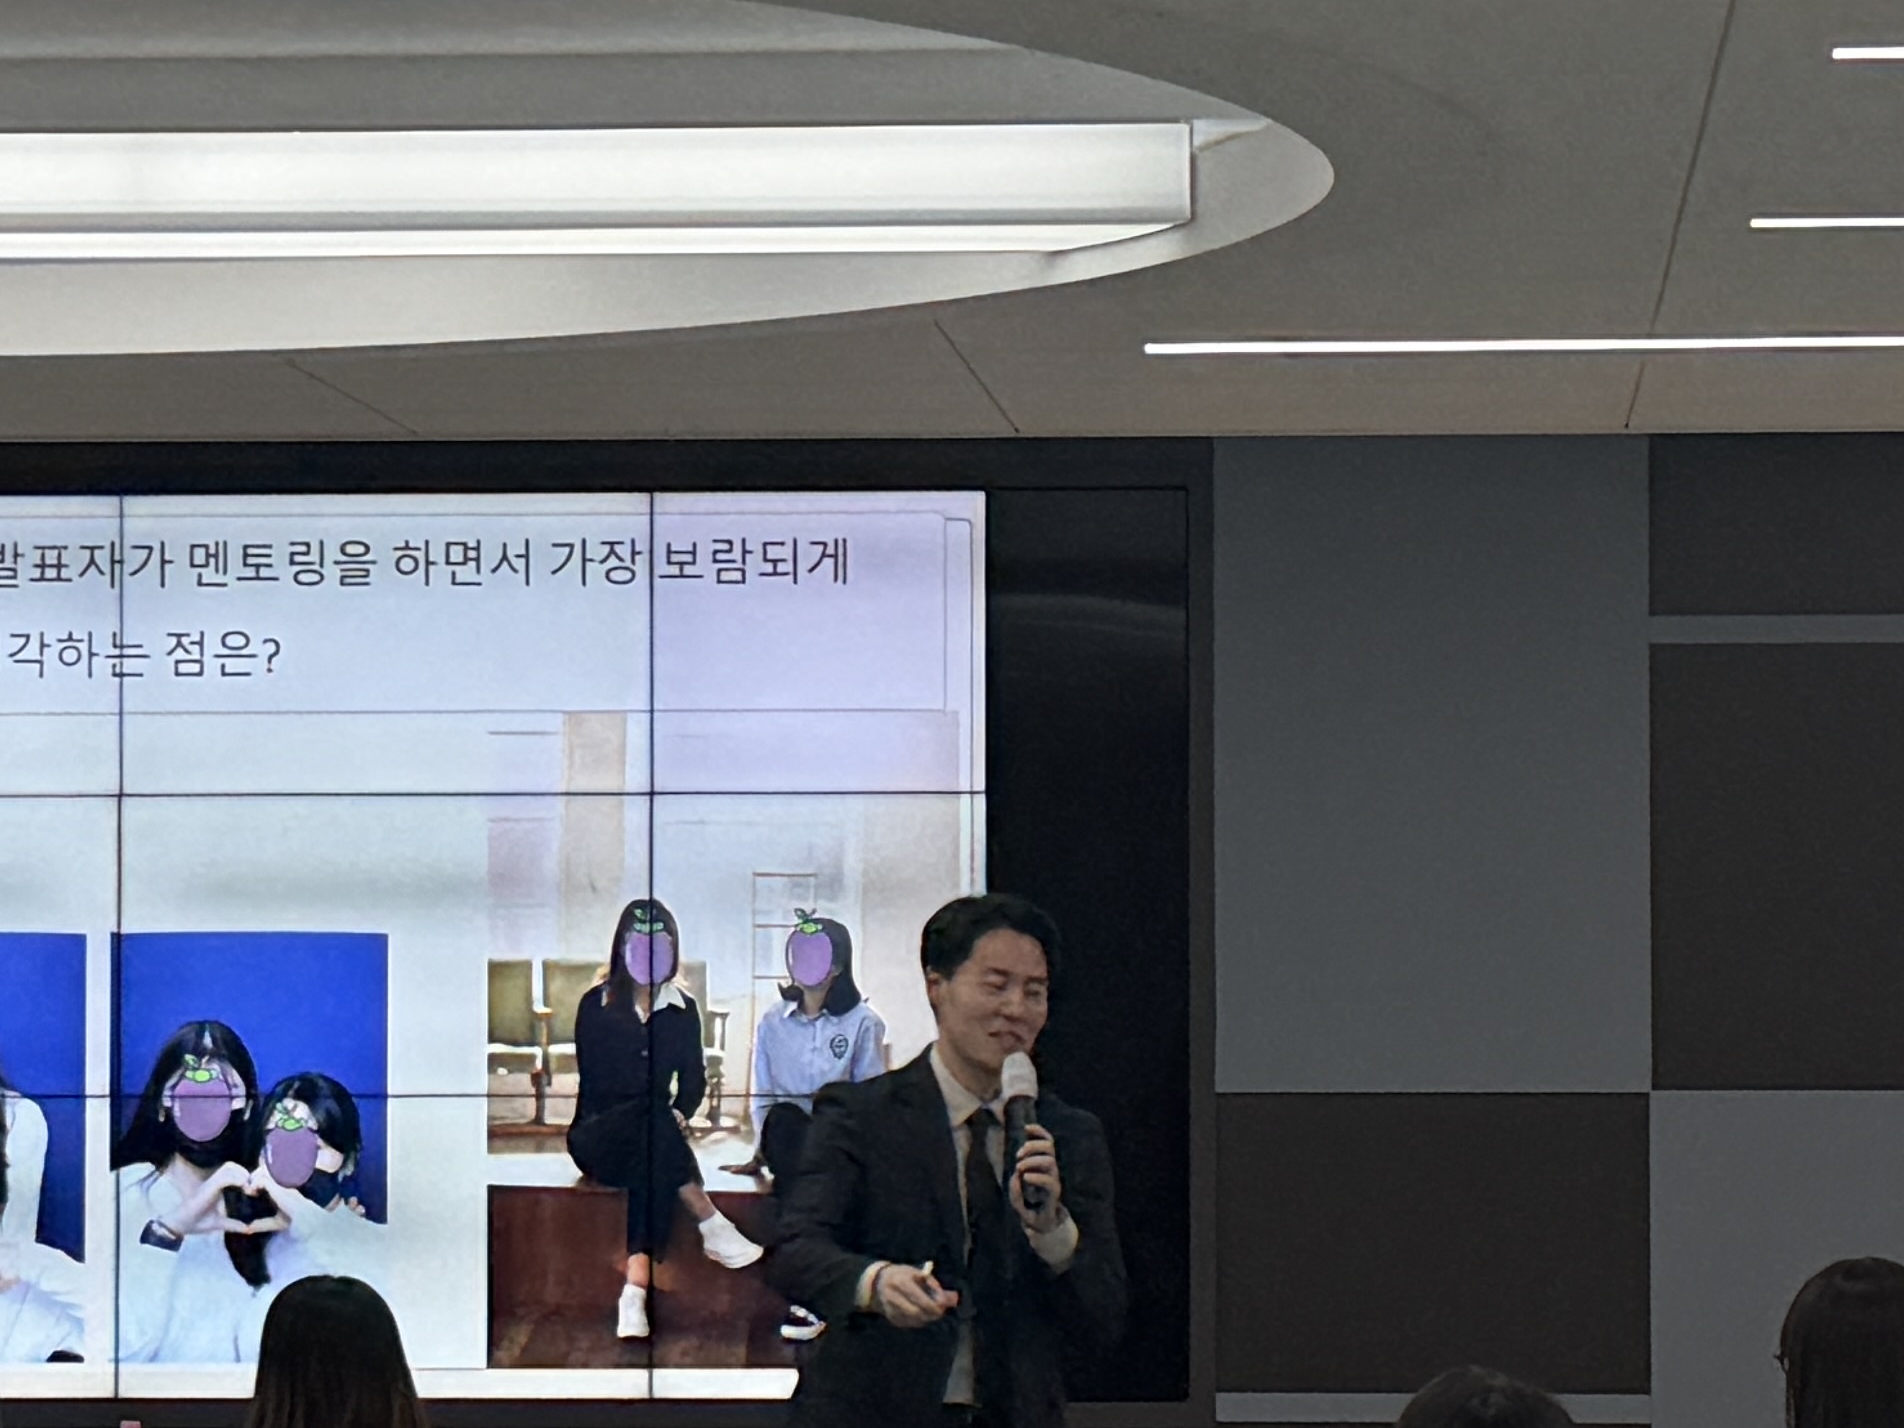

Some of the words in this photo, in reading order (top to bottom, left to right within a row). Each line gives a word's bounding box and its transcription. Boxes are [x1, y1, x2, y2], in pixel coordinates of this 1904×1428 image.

[188, 538, 378, 589] 멘토링을
[391, 537, 532, 588] 하면서
[550, 536, 644, 588] 가장
[657, 536, 848, 586] 보람되게
[165, 629, 282, 679] 점은?
